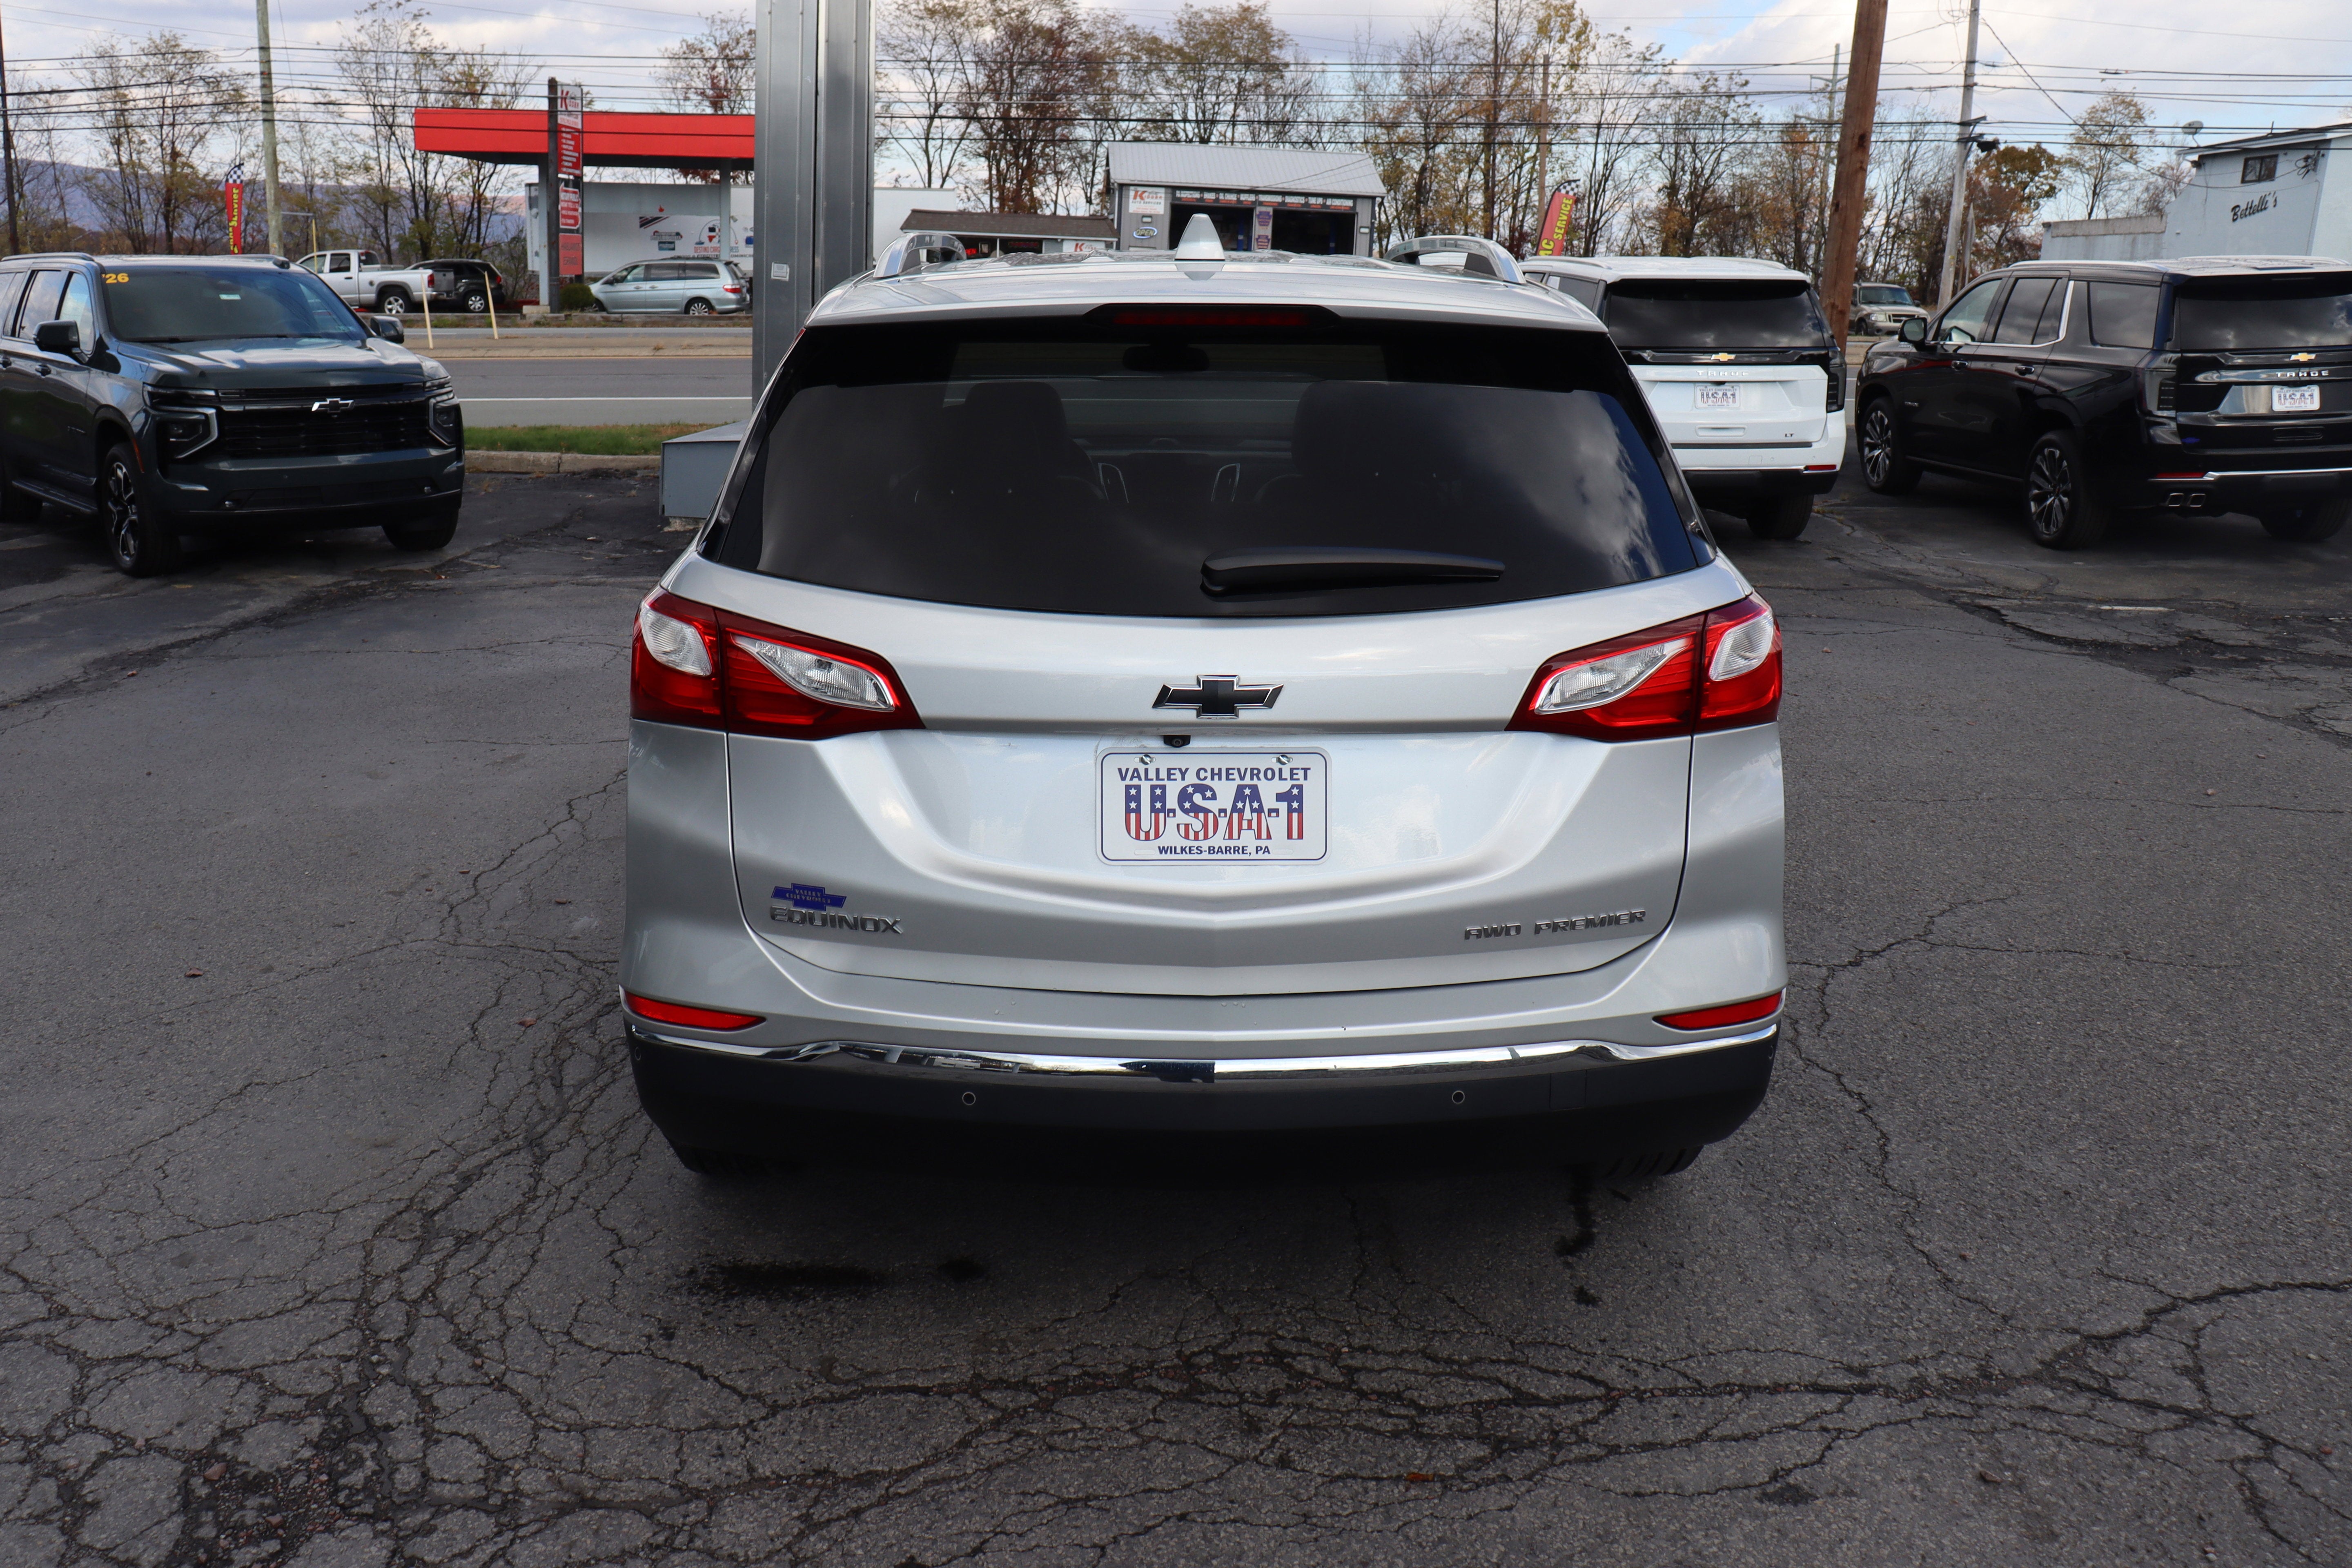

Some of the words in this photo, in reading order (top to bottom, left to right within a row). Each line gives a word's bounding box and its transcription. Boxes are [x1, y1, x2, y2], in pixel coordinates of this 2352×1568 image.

[1553, 197, 1573, 240] SERVICE
[1118, 767, 1189, 781] VALLEY
[1196, 767, 1311, 781] CHEVROLET
[1158, 846, 1252, 856] WILKES-BARRE,
[1255, 846, 1271, 855] PA
[786, 893, 831, 903] CHEVROLET
[770, 905, 903, 934] EQUINOX
[1464, 923, 1521, 940] AWD
[1534, 909, 1646, 935] PREMIER
